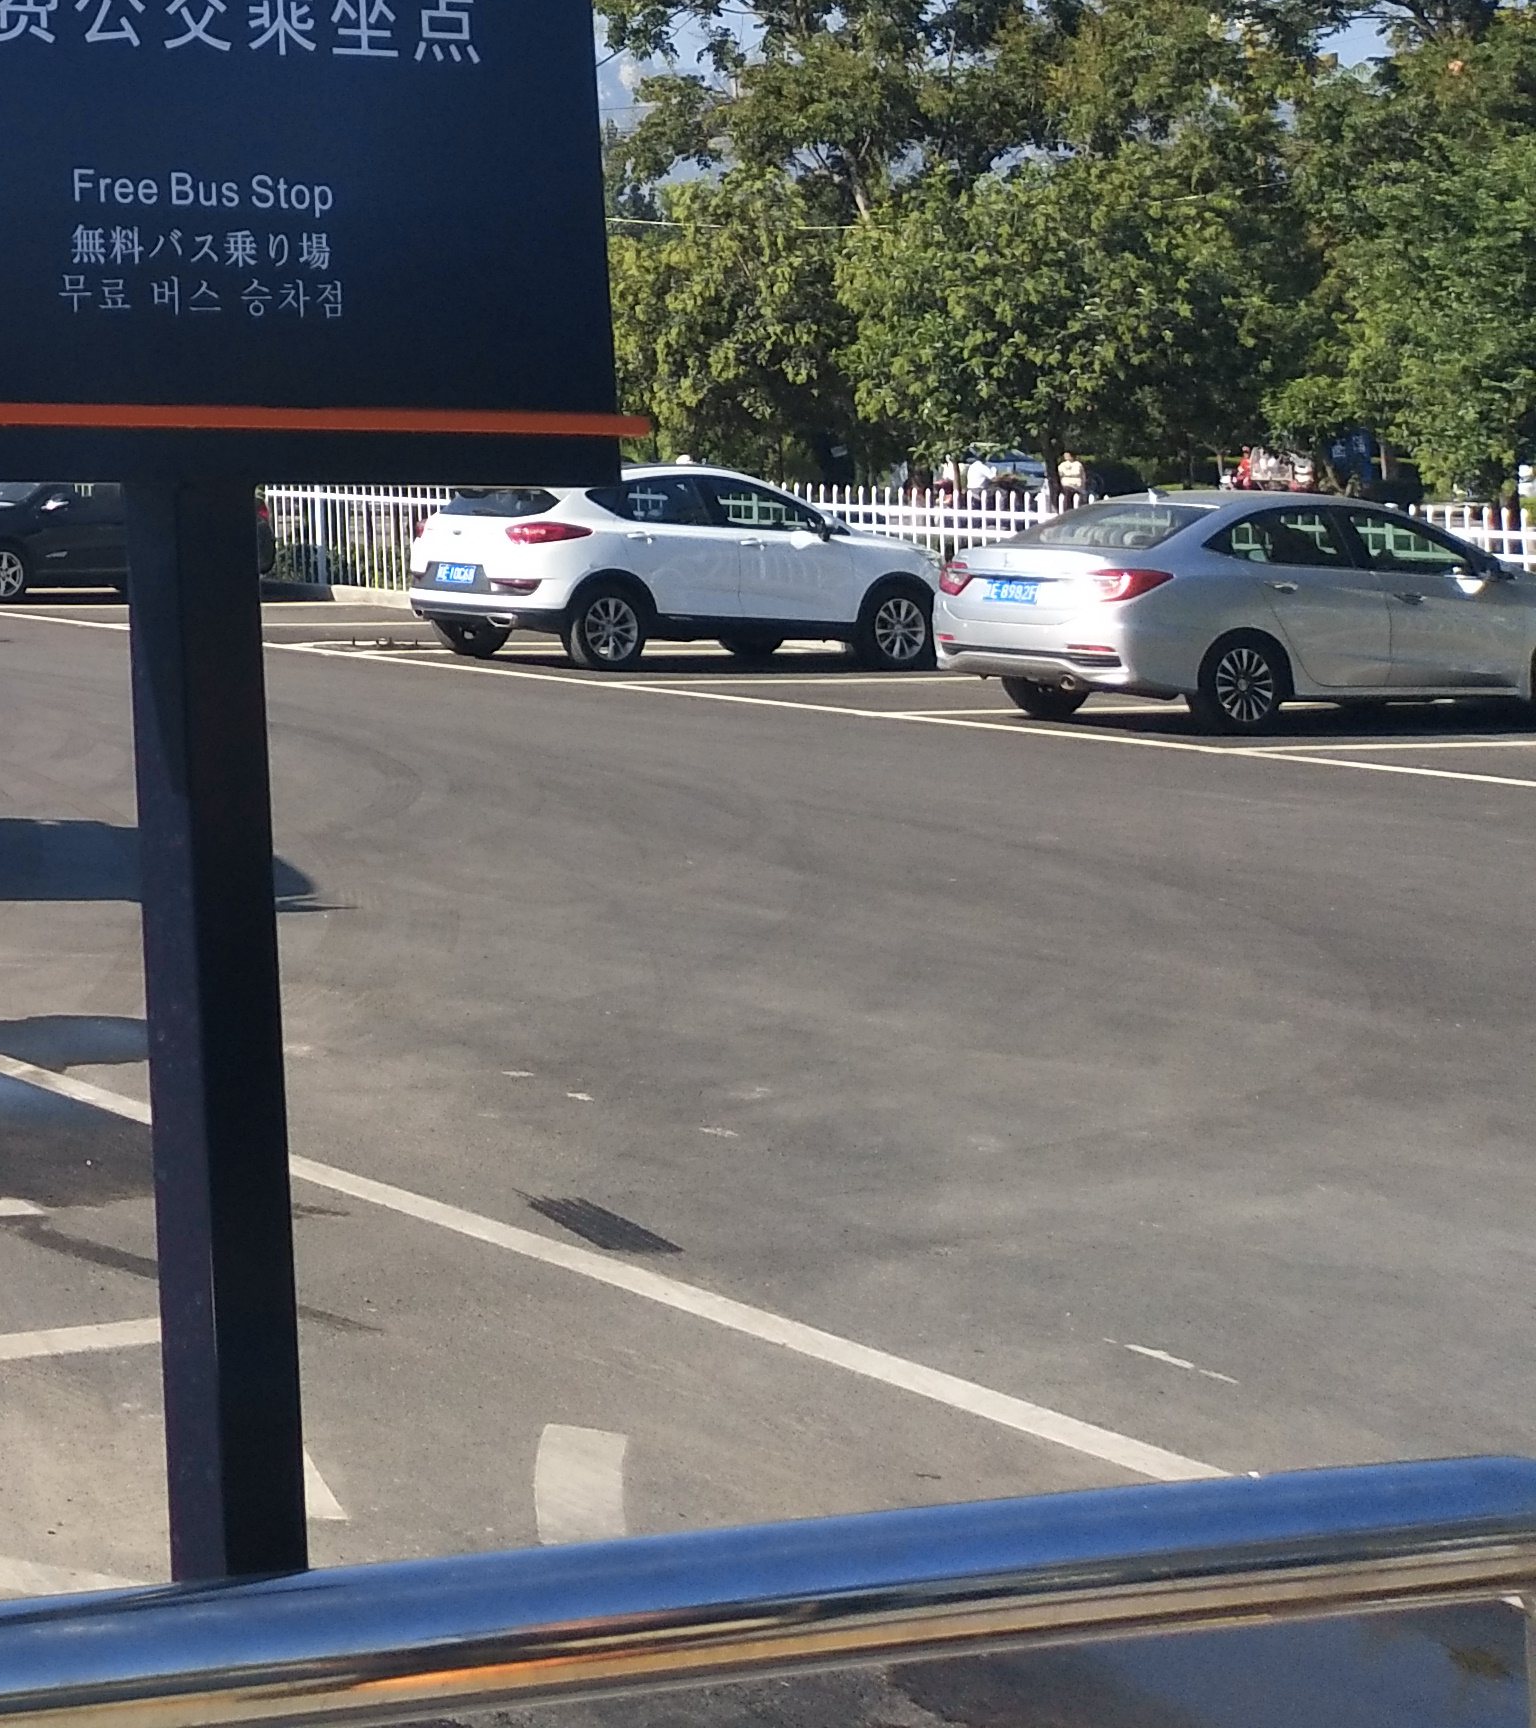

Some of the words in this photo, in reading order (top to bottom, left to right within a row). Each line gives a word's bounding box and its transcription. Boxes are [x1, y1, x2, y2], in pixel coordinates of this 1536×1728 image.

[72, 168, 158, 205] Free
[171, 172, 240, 209] Bus
[250, 174, 334, 217] Stop
[70, 224, 332, 270] 無料バス乗り場
[58, 274, 132, 314] 무료
[151, 276, 222, 316] 버스
[240, 279, 345, 319] 승차점
